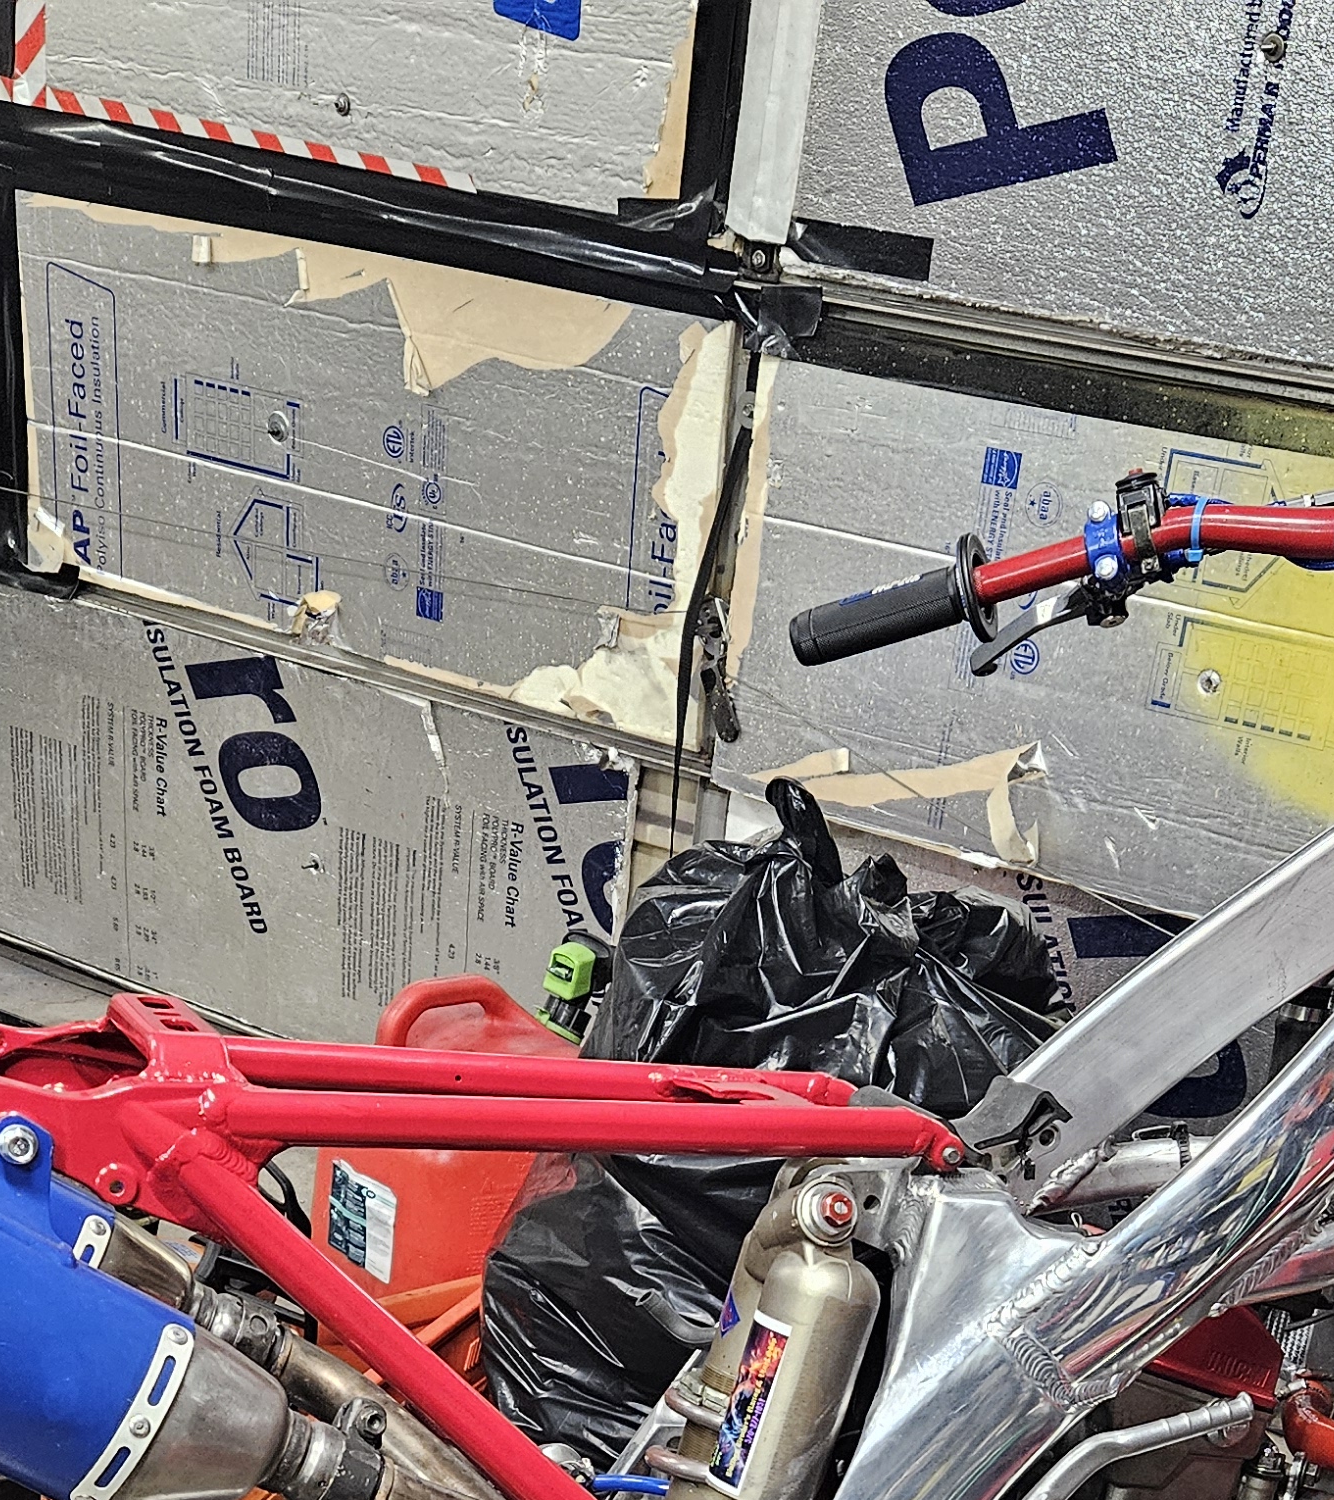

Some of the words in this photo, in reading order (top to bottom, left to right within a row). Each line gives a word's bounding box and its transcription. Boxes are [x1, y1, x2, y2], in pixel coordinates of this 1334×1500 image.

[1224, 12, 1261, 133] Manufactured
[90, 315, 101, 403] Insulation
[65, 317, 88, 492] Foil-Faced
[93, 409, 104, 508] Continuous
[986, 507, 999, 546] ENERGY
[1039, 488, 1051, 522] abaa
[72, 508, 90, 566] AP
[95, 515, 107, 574] Polyiso
[995, 529, 1007, 561] Insulat
[1171, 613, 1180, 637] Under
[154, 714, 167, 774] R-Value
[141, 617, 205, 758] SULATION
[192, 763, 234, 841] FOAM
[222, 845, 268, 937] BOARD
[155, 775, 169, 819] Chart
[452, 838, 460, 875] R-VALUE
[499, 818, 507, 865] THICKNESS
[503, 718, 565, 866] SULATION
[551, 872, 588, 938] FOA
[509, 818, 522, 883] R-Value
[505, 884, 517, 930] Chart
